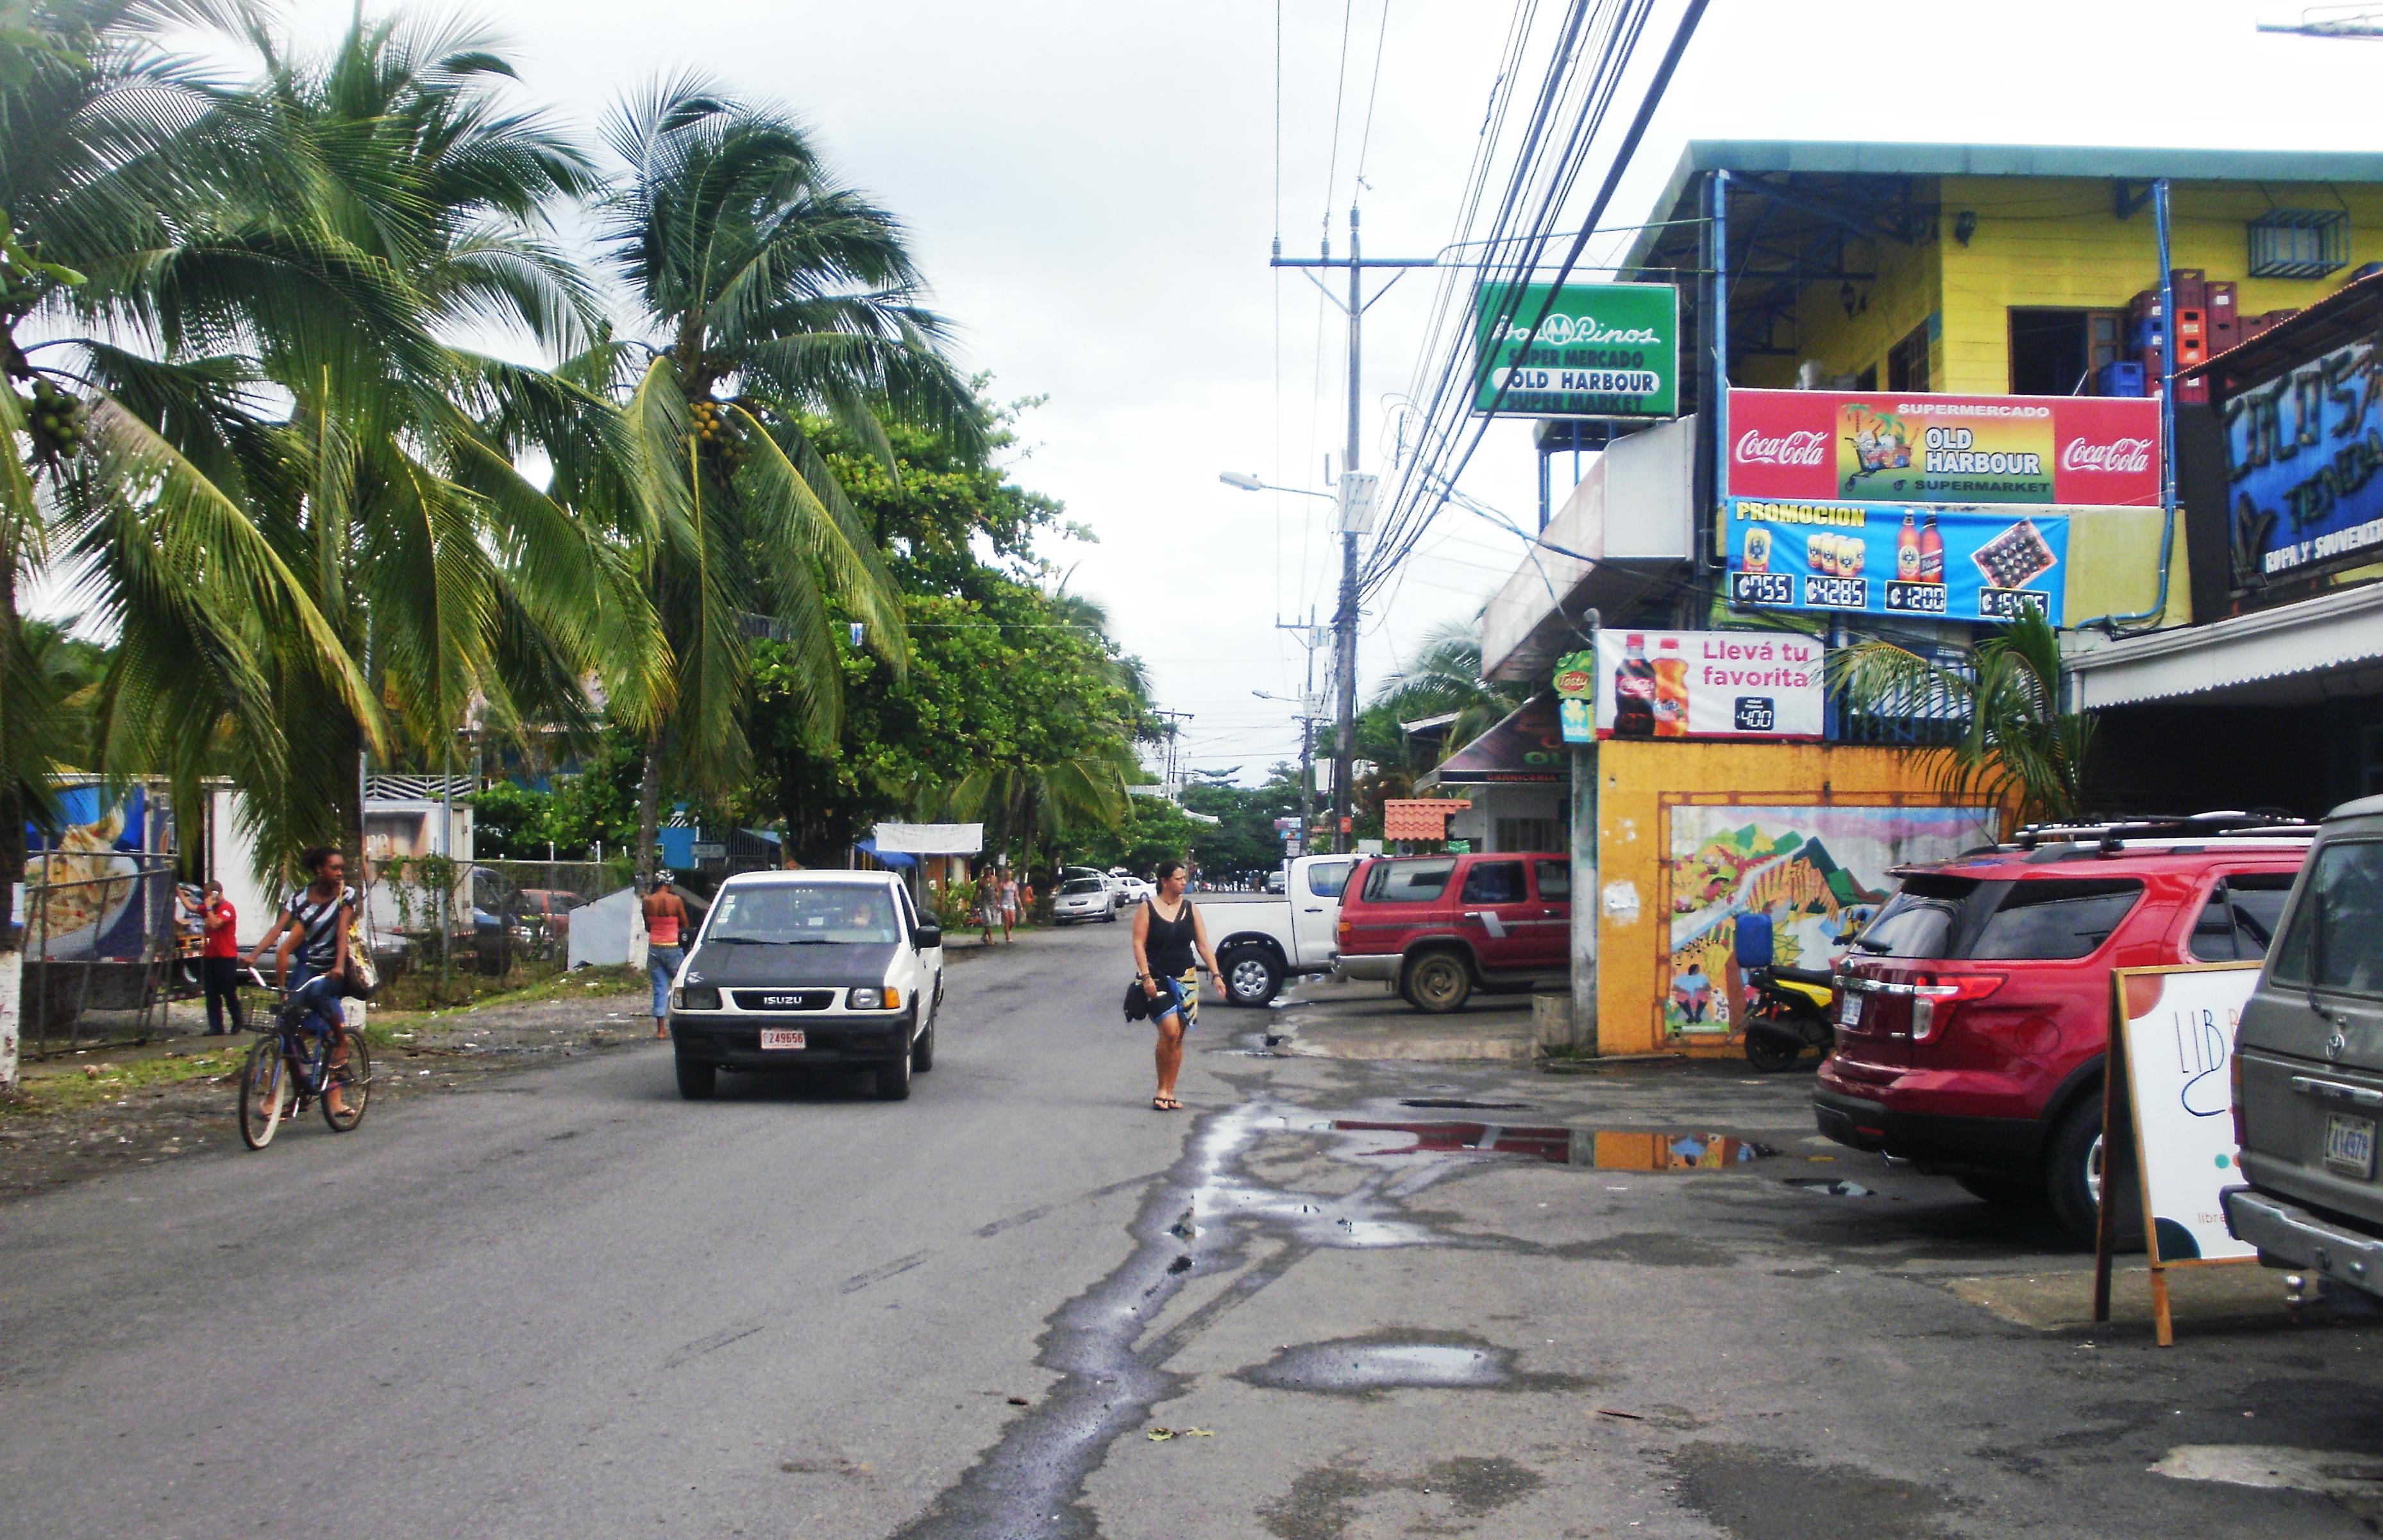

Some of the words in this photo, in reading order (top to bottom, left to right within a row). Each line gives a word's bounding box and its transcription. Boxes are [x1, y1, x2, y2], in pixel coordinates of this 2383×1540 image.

[1576, 317, 1660, 343] Pinos
[1564, 349, 1644, 369] MERCADO
[1511, 370, 1549, 389] OLD
[1561, 371, 1654, 392] HARBOUR
[1898, 403, 2050, 418] SUPERMERCADO
[1925, 427, 1973, 451] OLD
[1925, 451, 2041, 475] HARBOUR
[1914, 480, 2050, 494] SUPERMARKET
[1736, 501, 1866, 528] PROMOCION
[1703, 640, 1774, 660] Llevá
[1781, 643, 1808, 662] tu
[1703, 665, 1808, 687] favorita
